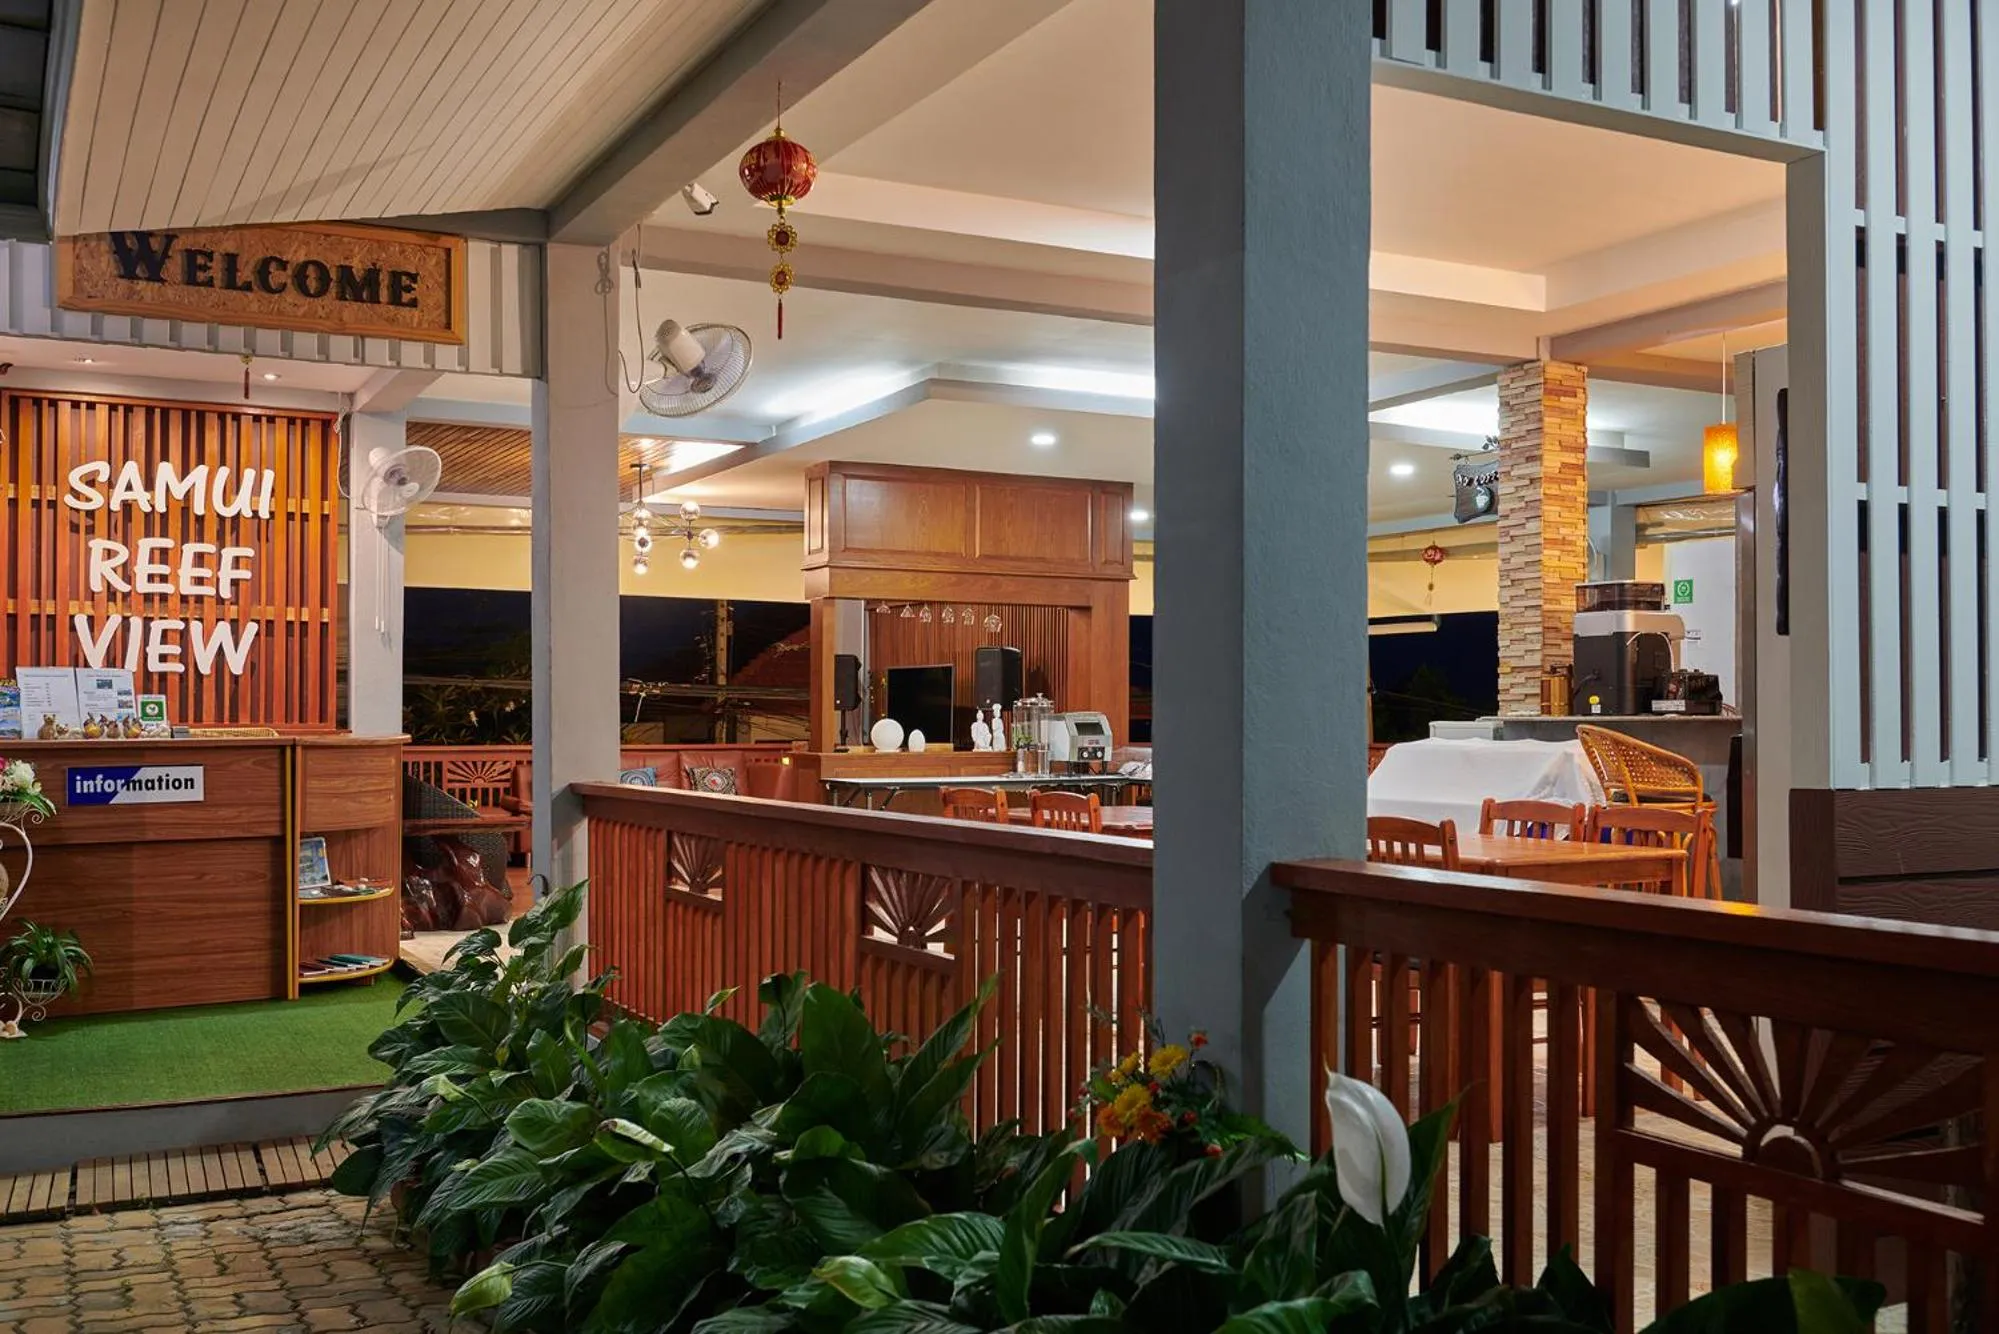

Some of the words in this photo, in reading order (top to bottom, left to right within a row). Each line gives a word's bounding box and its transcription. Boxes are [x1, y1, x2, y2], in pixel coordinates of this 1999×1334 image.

[109, 231, 420, 308] WELCOME
[64, 460, 275, 519] SAMUI
[88, 537, 255, 599] REEF
[74, 613, 259, 675] VIEW
[75, 773, 195, 794] information
